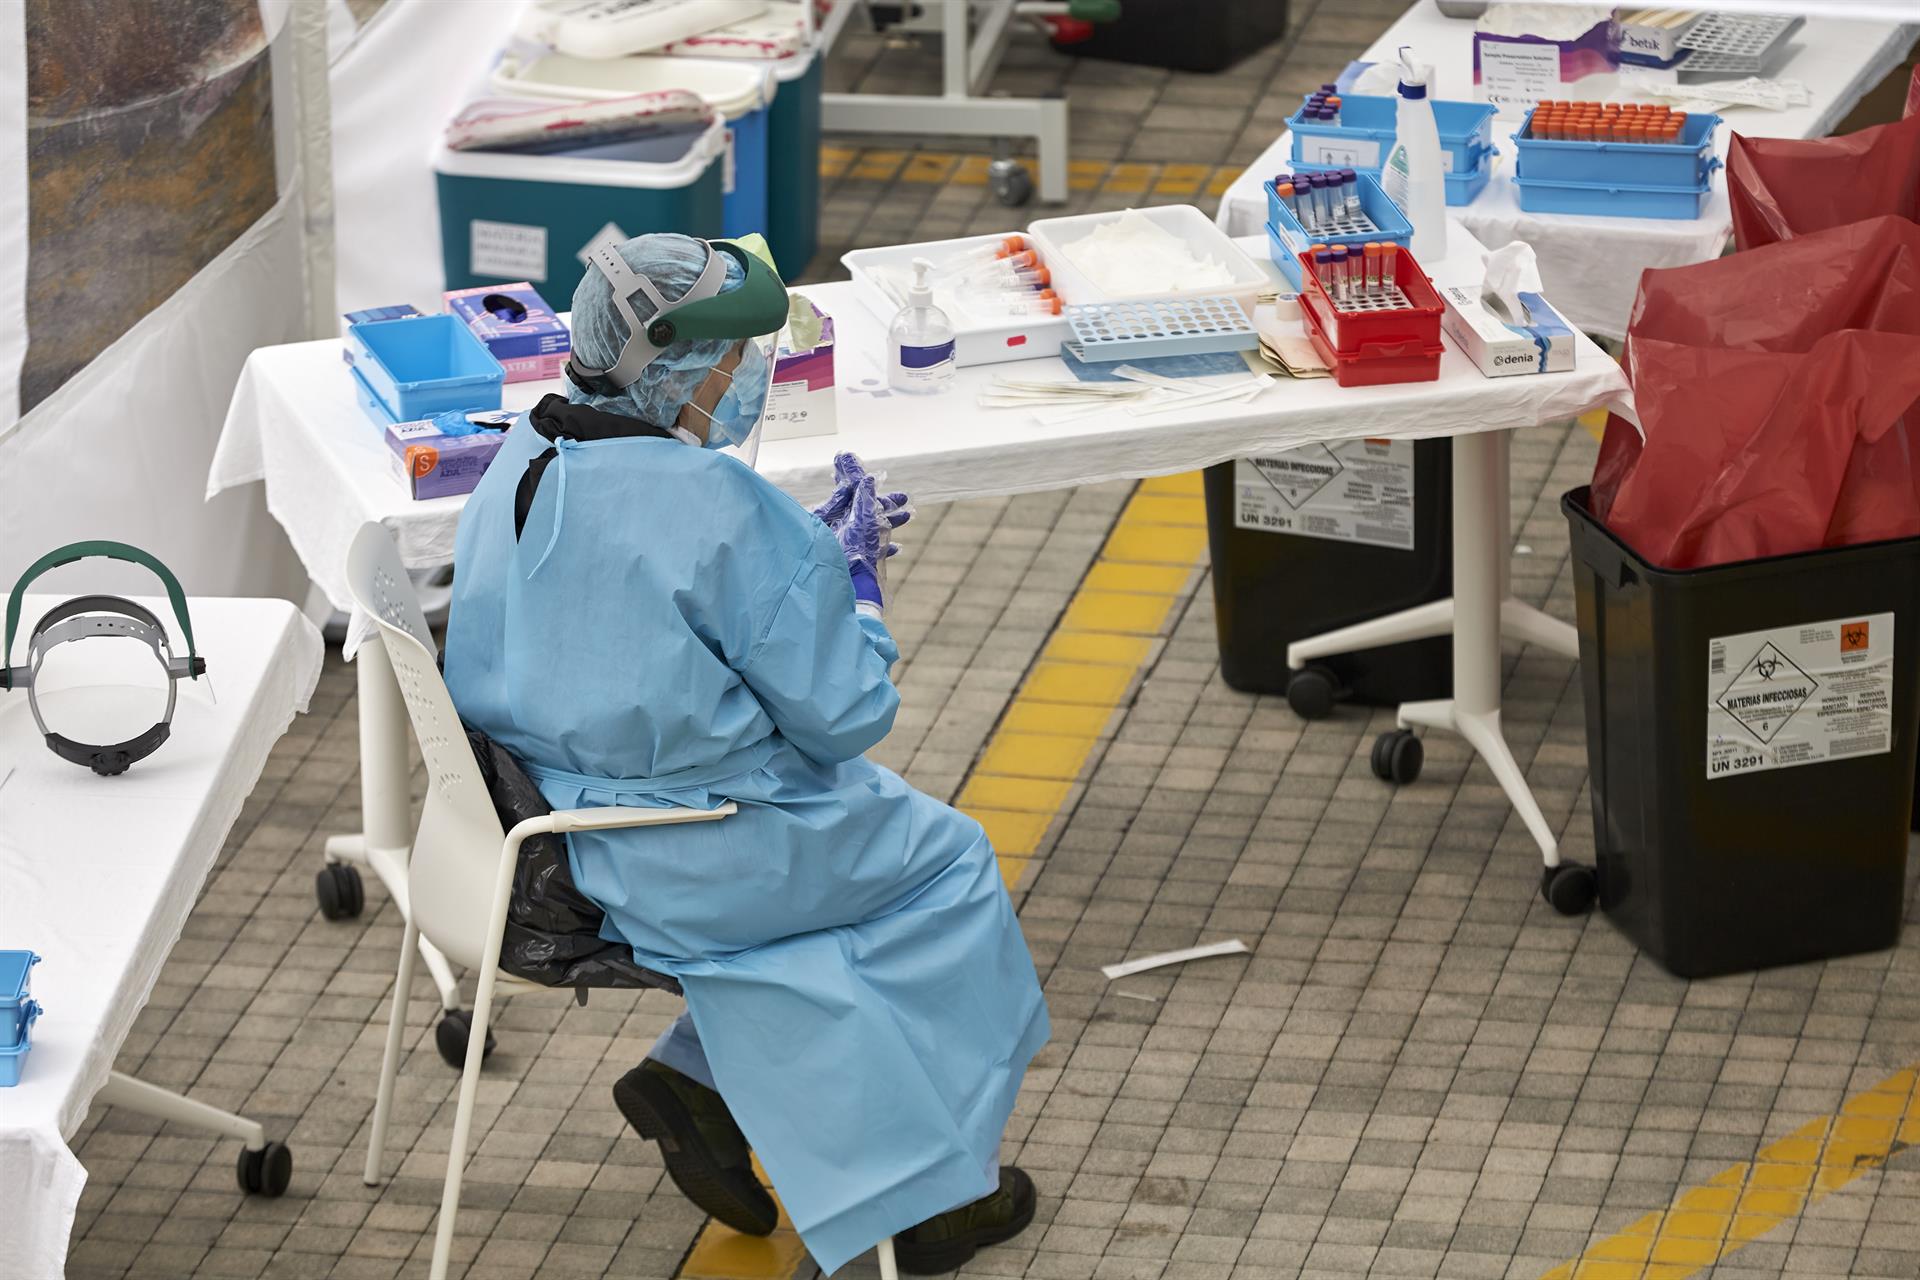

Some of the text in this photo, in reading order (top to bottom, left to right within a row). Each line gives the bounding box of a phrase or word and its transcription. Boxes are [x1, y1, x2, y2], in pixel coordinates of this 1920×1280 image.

[1504, 353, 1534, 364] denia
[419, 454, 430, 471] S
[1255, 457, 1290, 471] MATERIAS
[1290, 461, 1334, 476] INFECCIOSAS
[1241, 512, 1259, 525] UN
[1263, 515, 1292, 529] 3291
[1727, 687, 1807, 710] MATERIAS INFECCIOSAS
[1762, 722, 1769, 731] 6
[1711, 754, 1764, 774] UN 3291
